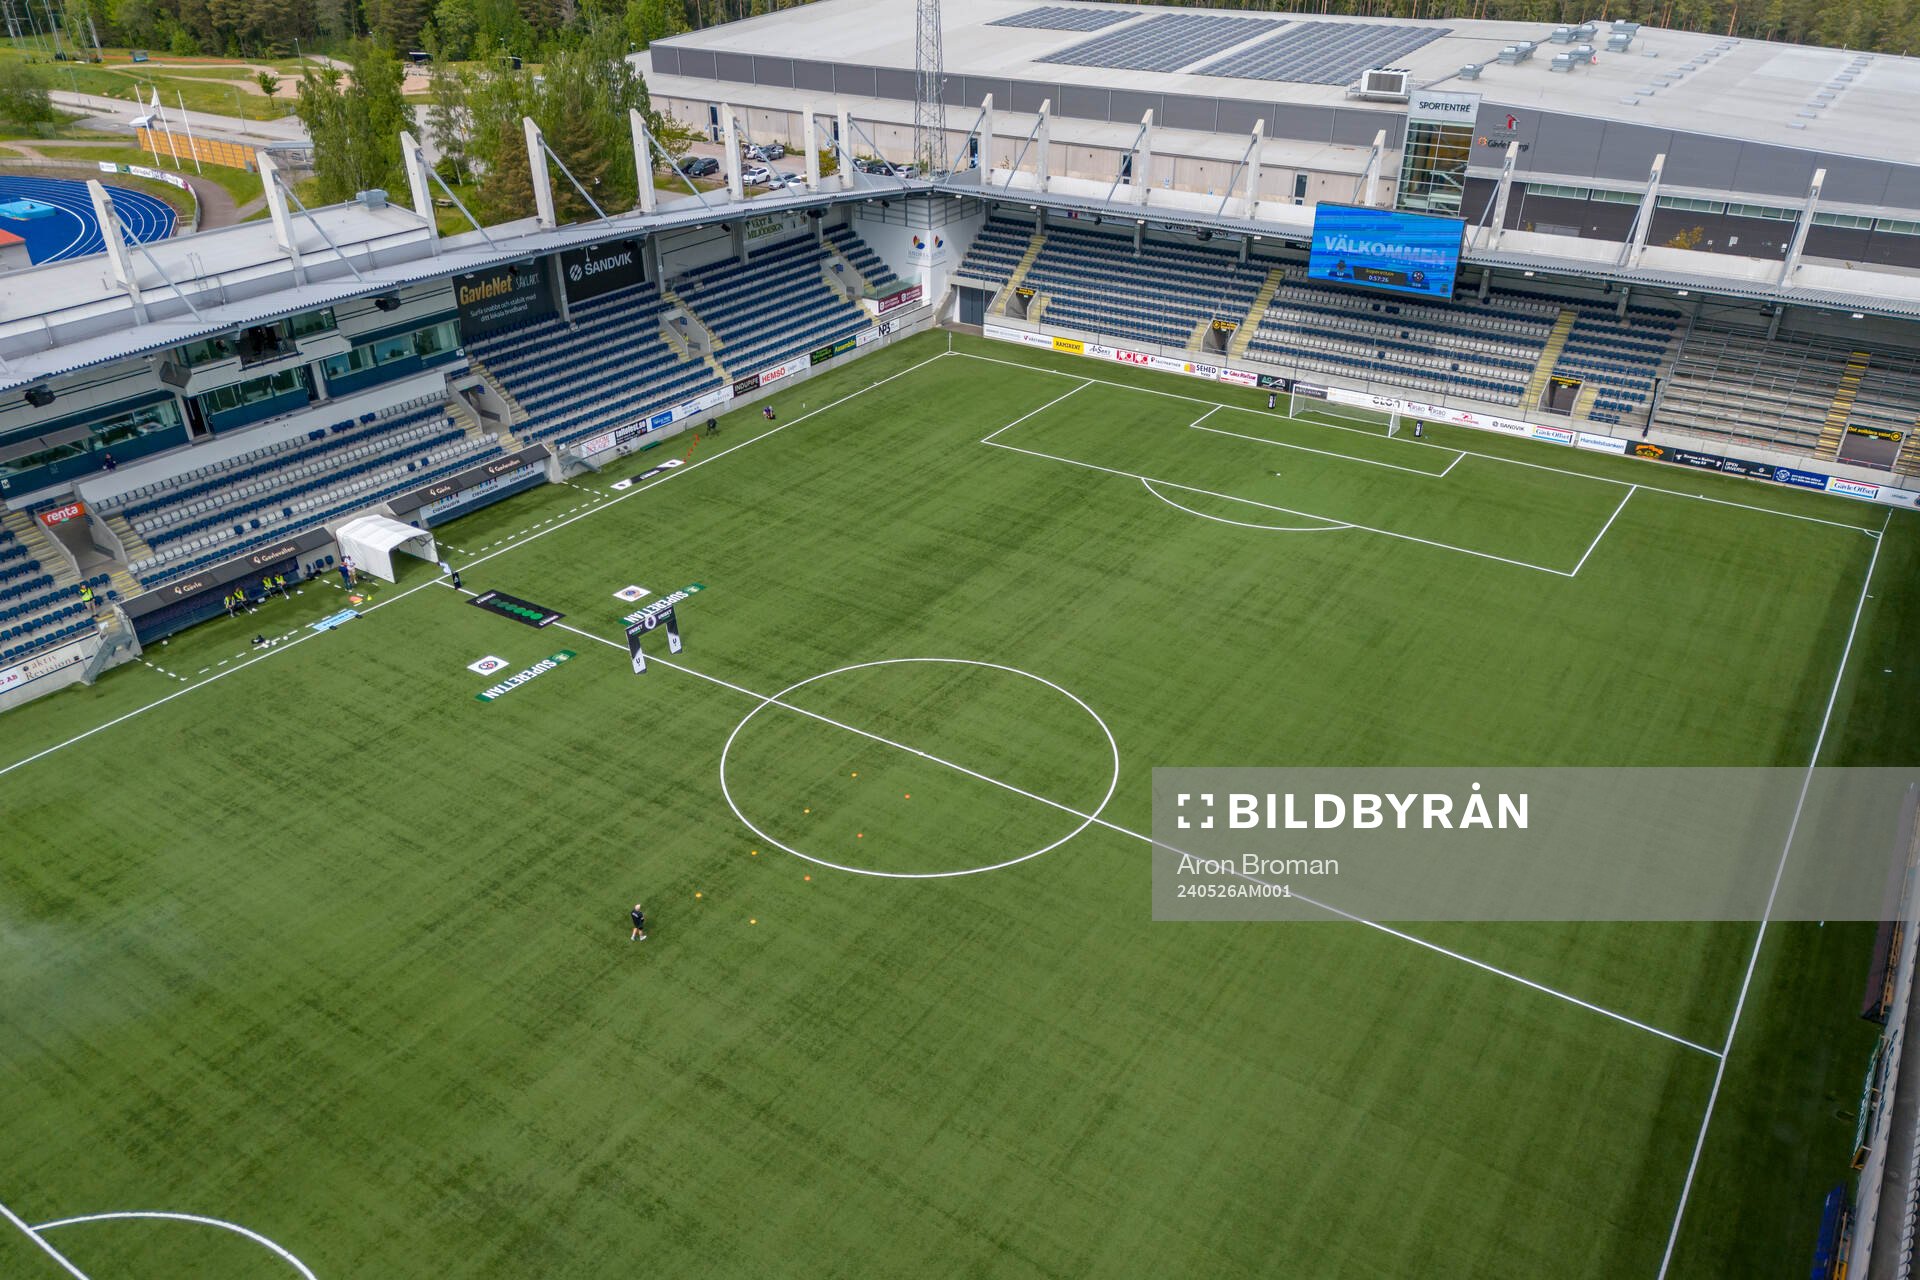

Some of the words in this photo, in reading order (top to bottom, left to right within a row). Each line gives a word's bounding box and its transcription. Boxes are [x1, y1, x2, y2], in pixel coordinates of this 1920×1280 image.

[1419, 101, 1472, 113] SPORTENTRÉ
[1324, 234, 1447, 264] VÄLKOMMEN
[585, 251, 632, 276] SANDVIK
[460, 274, 513, 305] GavleNet
[879, 322, 891, 337] NP3
[1055, 341, 1081, 351] RAMIRENT
[761, 367, 786, 384] HEMSÖ
[1196, 364, 1217, 374] SEHED
[1500, 422, 1525, 431] SANDVIK
[47, 505, 78, 522] renta
[482, 659, 557, 699] SUPERETTAN
